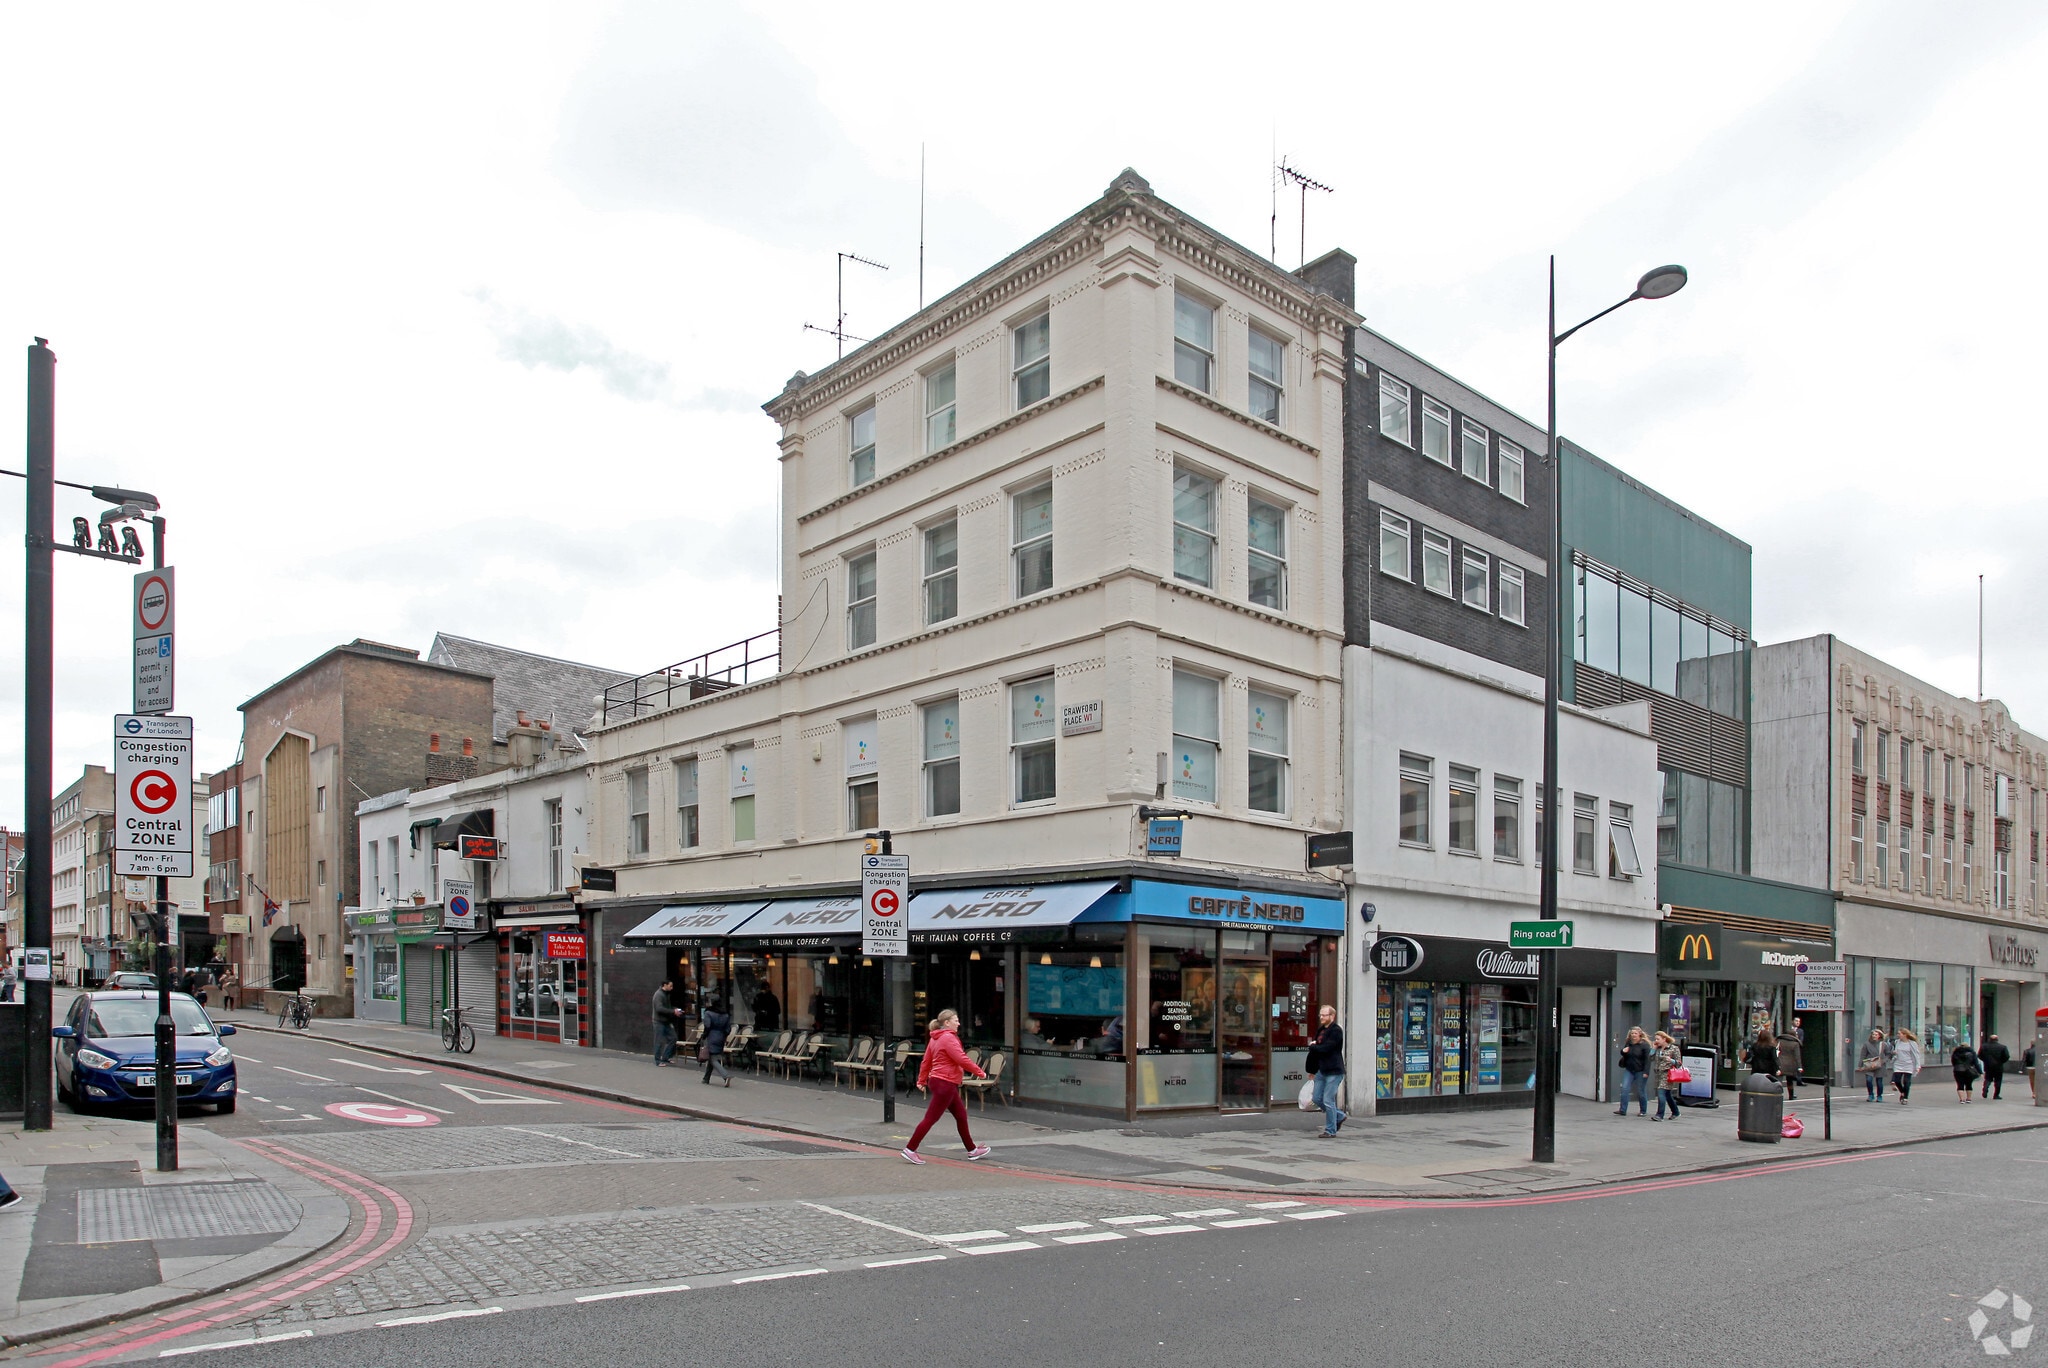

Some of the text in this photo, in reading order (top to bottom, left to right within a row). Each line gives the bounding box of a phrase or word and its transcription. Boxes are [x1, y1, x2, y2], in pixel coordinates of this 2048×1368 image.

[138, 646, 158, 656] Except
[140, 662, 160, 673] permit
[140, 674, 162, 684] holders
[148, 686, 159, 694] and
[138, 697, 168, 708] for access
[1064, 702, 1098, 716] CRAWFORD
[146, 720, 179, 730] Transport
[1064, 714, 1093, 726] PLACE W1
[120, 740, 187, 753] Congestion
[128, 753, 179, 765] charging
[126, 818, 182, 831] Central
[131, 833, 176, 846] ZONE
[1150, 836, 1180, 845] NERO
[134, 854, 154, 862] Mon
[161, 855, 173, 863] Fri
[864, 871, 906, 879] Congestion
[446, 882, 473, 890] Controlled
[869, 878, 900, 887] charging
[519, 904, 536, 912] SALWA
[932, 900, 1047, 919] NERO
[1252, 902, 1305, 922] NERO
[659, 914, 728, 928] NERO
[772, 909, 861, 926] NERO
[868, 920, 902, 928] Central
[871, 928, 898, 937] ZONE
[912, 934, 924, 942] THE
[930, 934, 958, 942] ITALIAN
[964, 933, 995, 941] COFFEE
[1513, 930, 1556, 939] Ring road
[1381, 950, 1408, 967] Hill
[1477, 949, 1540, 976] William Hi
[1060, 1078, 1082, 1086] NERO
